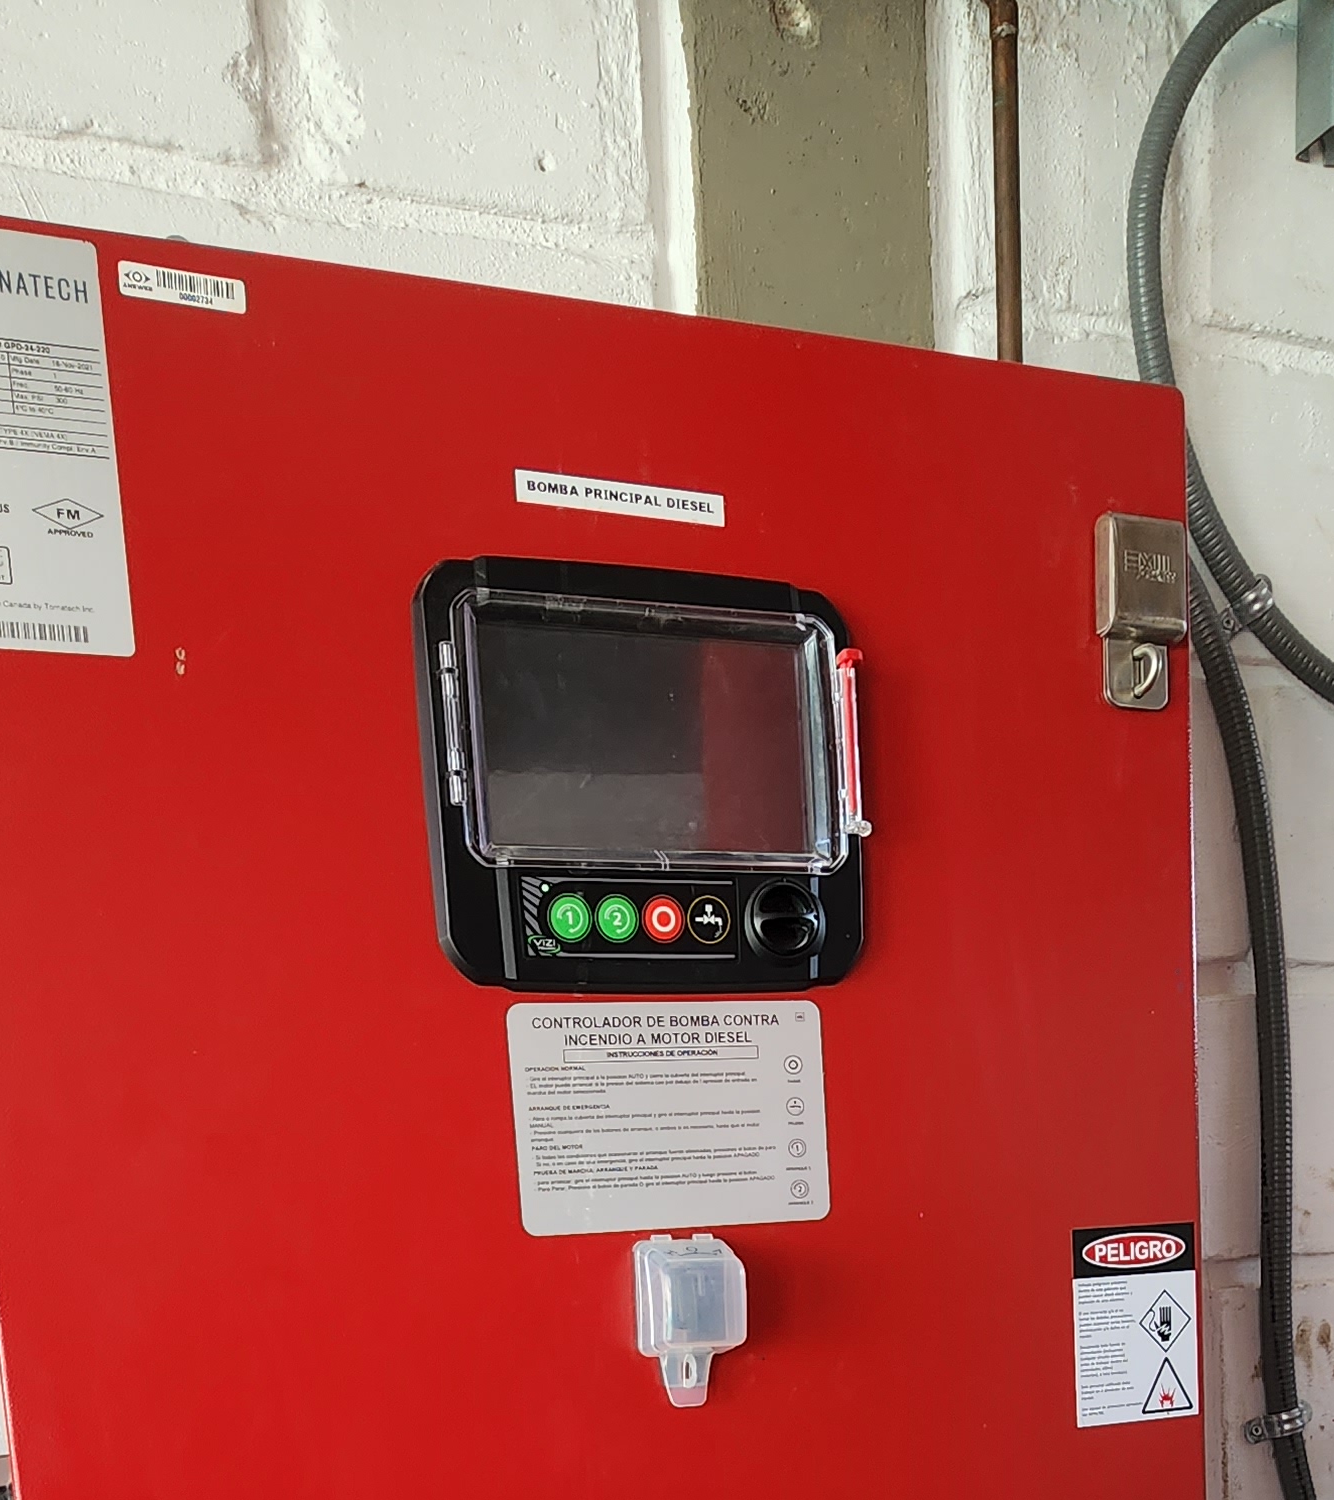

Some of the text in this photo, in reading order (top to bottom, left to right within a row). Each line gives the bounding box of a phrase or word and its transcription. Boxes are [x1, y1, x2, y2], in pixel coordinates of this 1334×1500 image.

[527, 480, 714, 514] BOMBA PRINCIPAL DIESEL
[56, 508, 81, 521] FM
[47, 528, 94, 538] APPROVED
[532, 1014, 779, 1029] CONTROLADOR DE BOMBA CONTRA
[565, 1031, 752, 1046] INCENDIO A MOTOR DIESEL
[1094, 1240, 1176, 1262] PELIGRO
